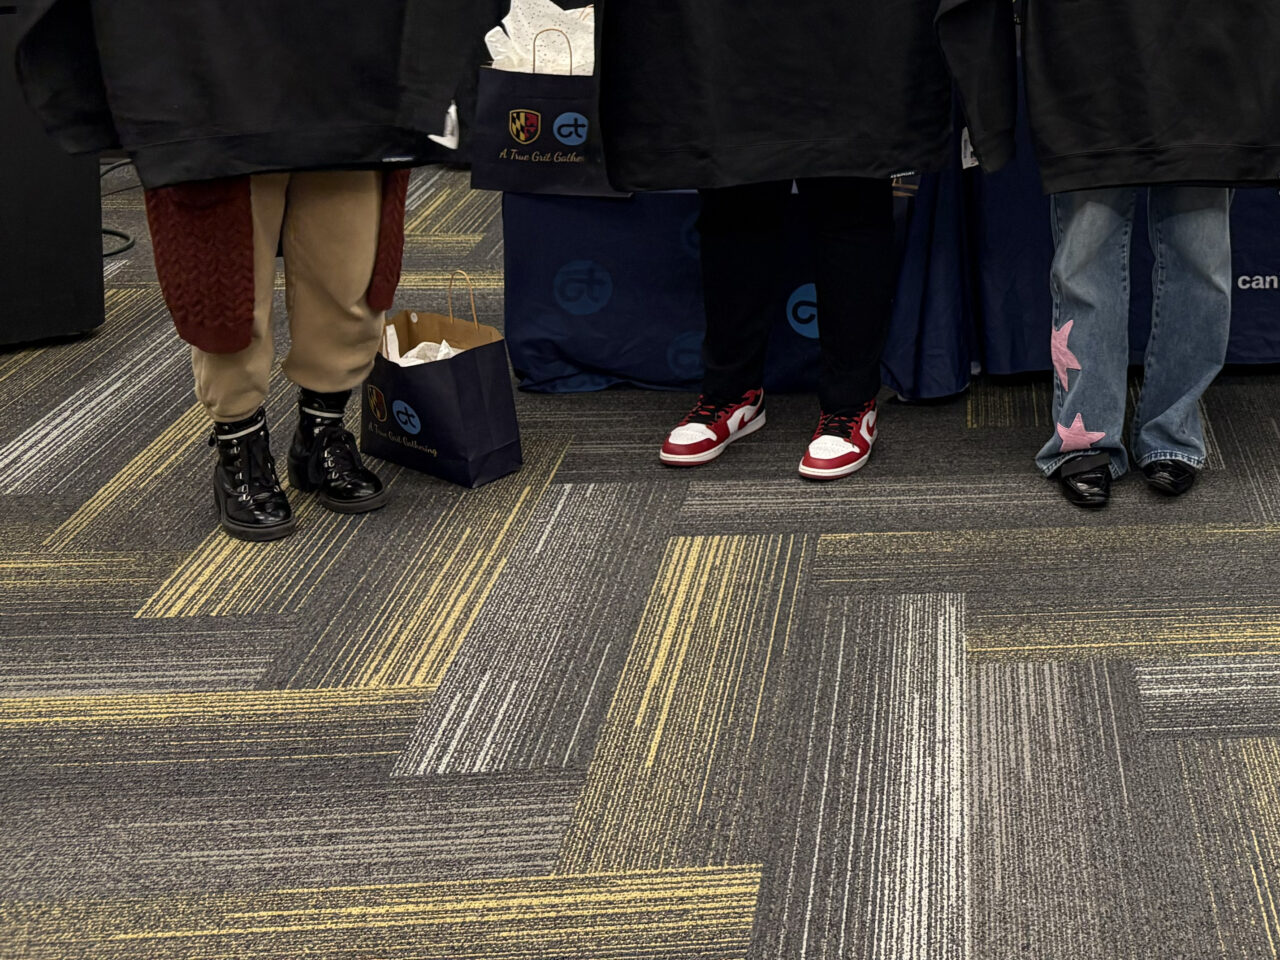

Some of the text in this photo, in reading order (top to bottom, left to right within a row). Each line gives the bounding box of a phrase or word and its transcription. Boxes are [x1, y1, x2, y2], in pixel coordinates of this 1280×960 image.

[499, 148, 508, 159] A
[510, 148, 530, 161] True
[531, 151, 552, 162] Grit
